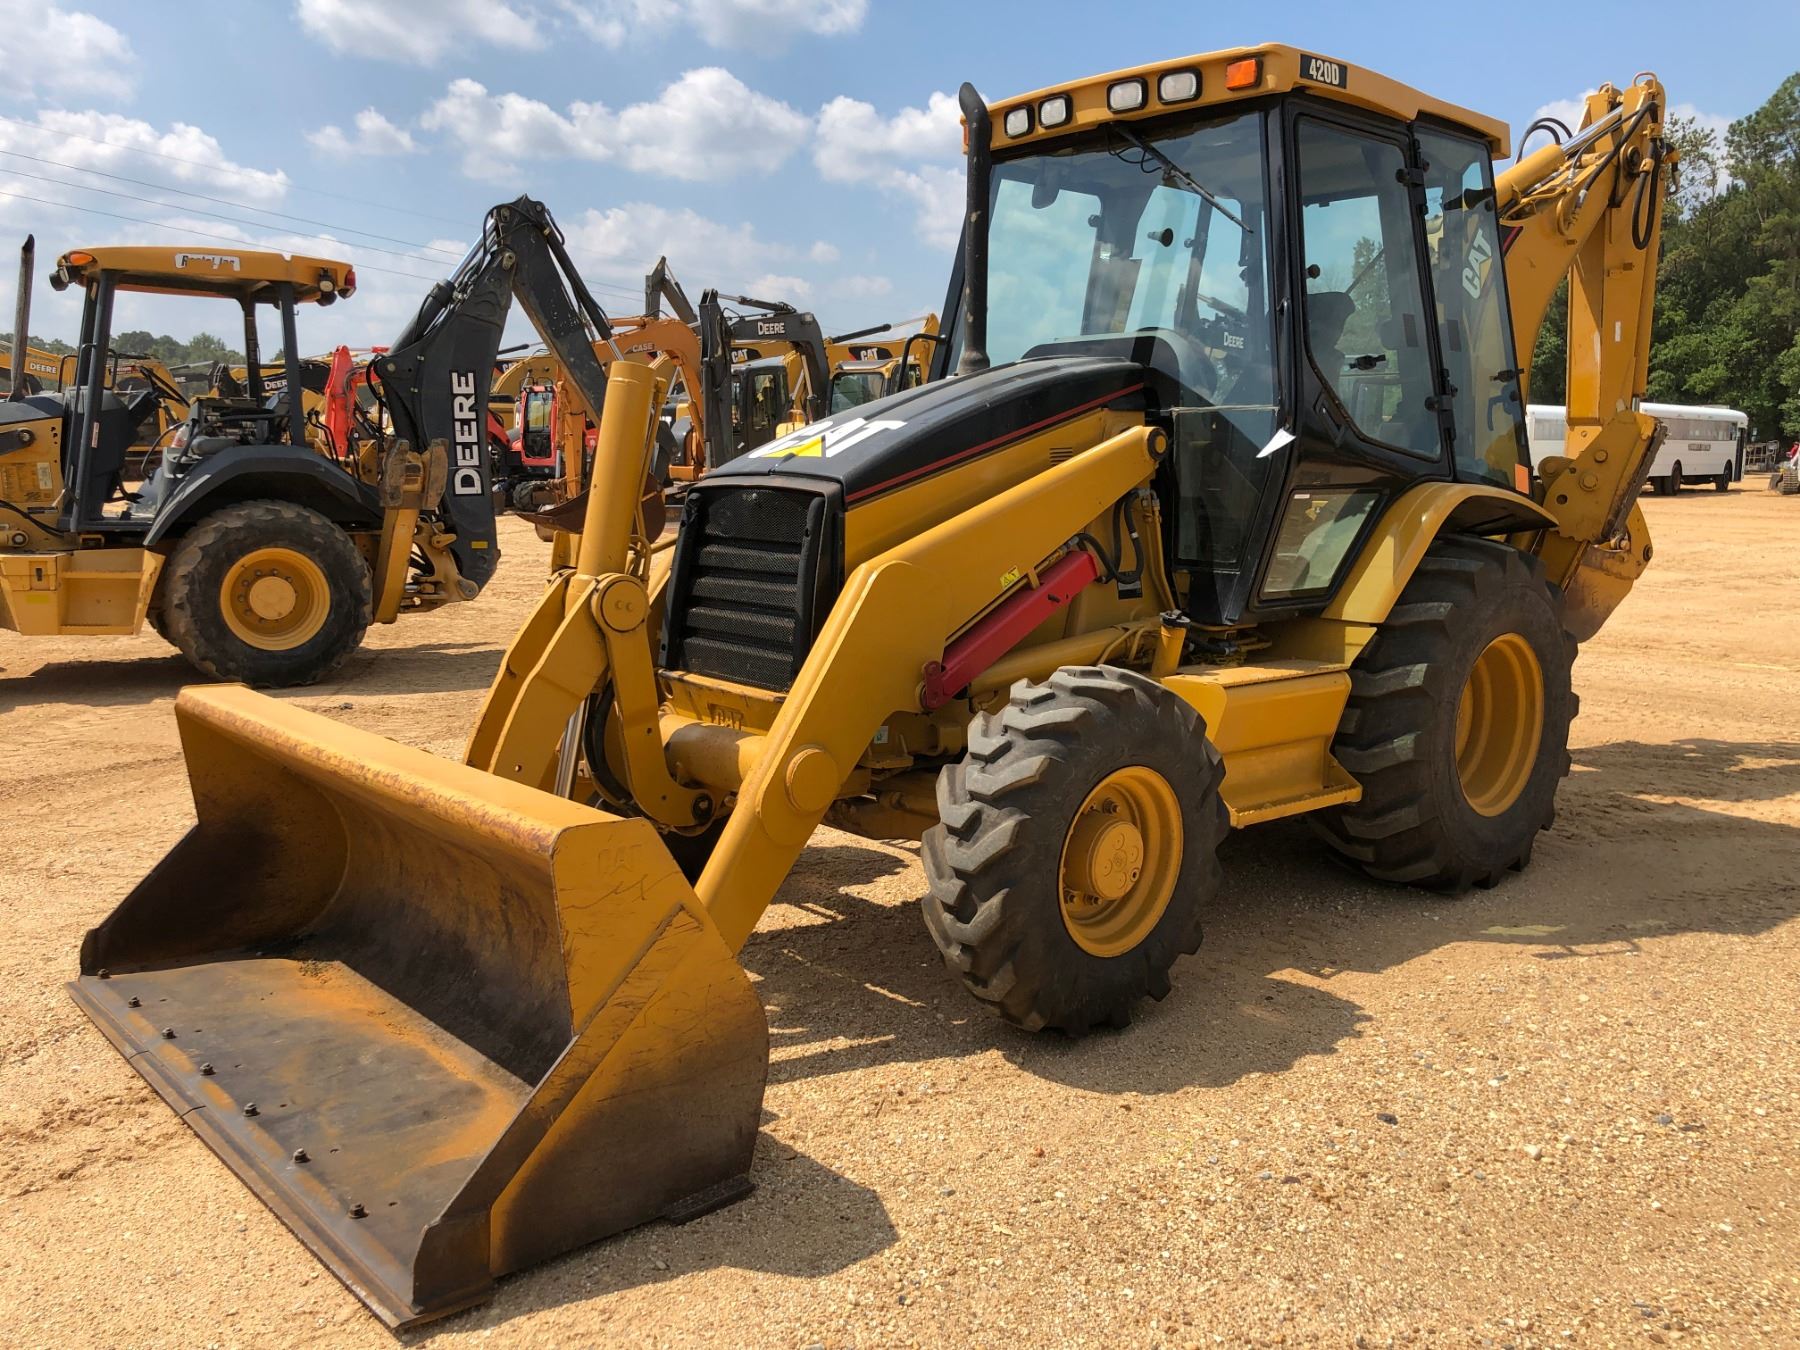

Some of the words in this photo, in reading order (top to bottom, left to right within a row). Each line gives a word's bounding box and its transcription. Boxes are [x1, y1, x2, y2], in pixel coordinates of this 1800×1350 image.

[1309, 59, 1340, 85] 420D
[1462, 227, 1493, 299] CAT
[757, 321, 786, 336] DEERE
[632, 343, 654, 353] CASE
[1223, 332, 1244, 349] DEERE
[731, 349, 748, 363] CAT
[860, 347, 878, 362] CAT
[29, 361, 57, 374] DEERE
[263, 379, 289, 390] DEER
[452, 372, 482, 495] DEERE
[747, 417, 908, 459] CAT
